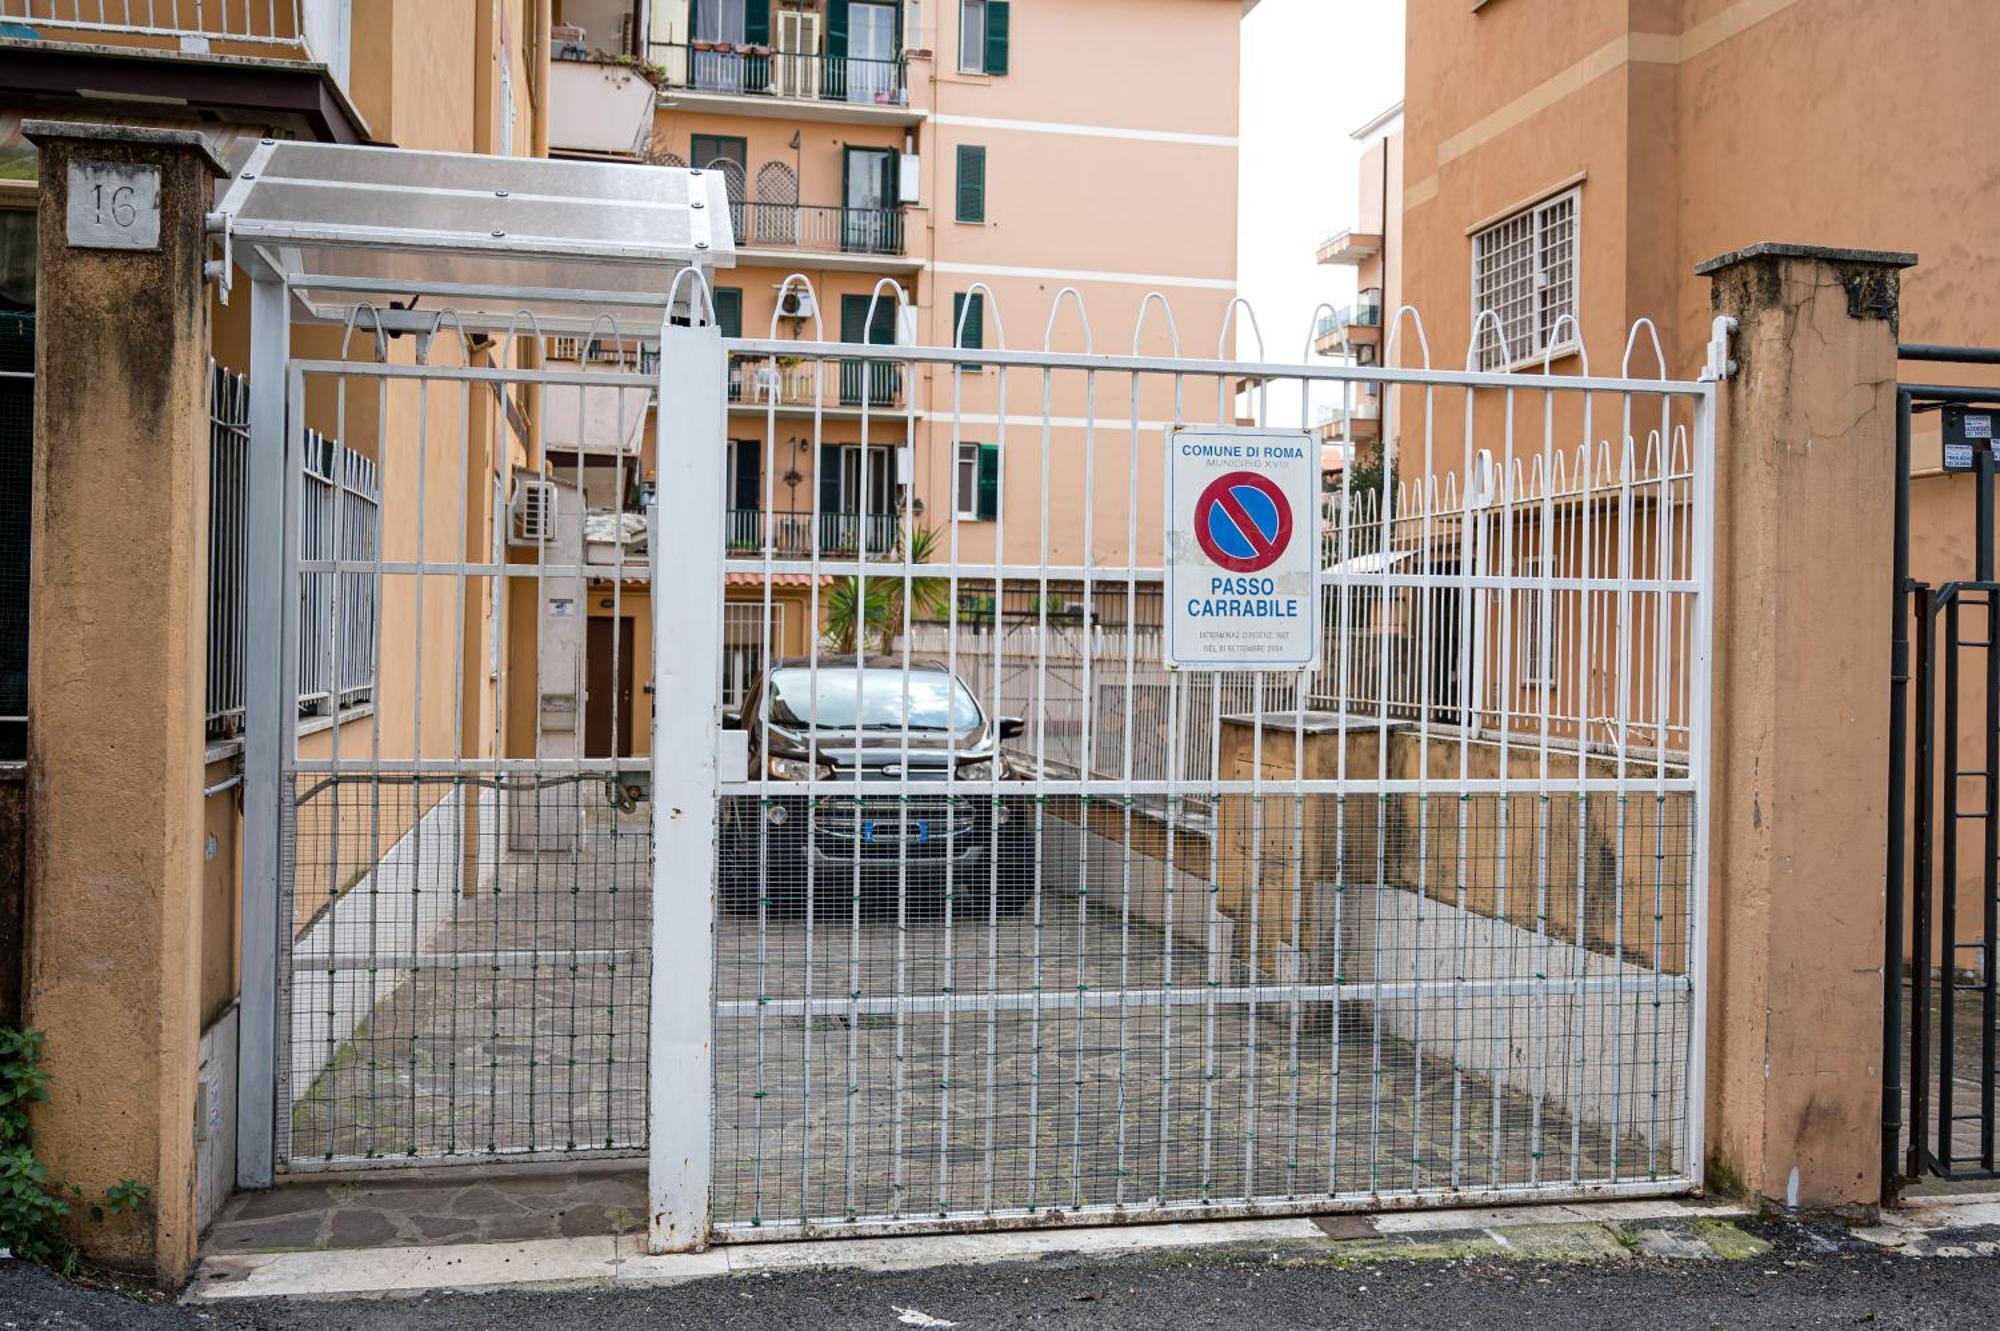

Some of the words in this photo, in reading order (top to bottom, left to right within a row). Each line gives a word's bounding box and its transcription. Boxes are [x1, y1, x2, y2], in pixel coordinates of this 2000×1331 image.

[91, 184, 136, 228] 16
[1182, 445, 1242, 457] COMUNE
[1246, 446, 1259, 457] DI
[1264, 447, 1304, 458] ROMA
[1211, 577, 1275, 595] PASSO
[1187, 599, 1298, 617] CARRABILE
